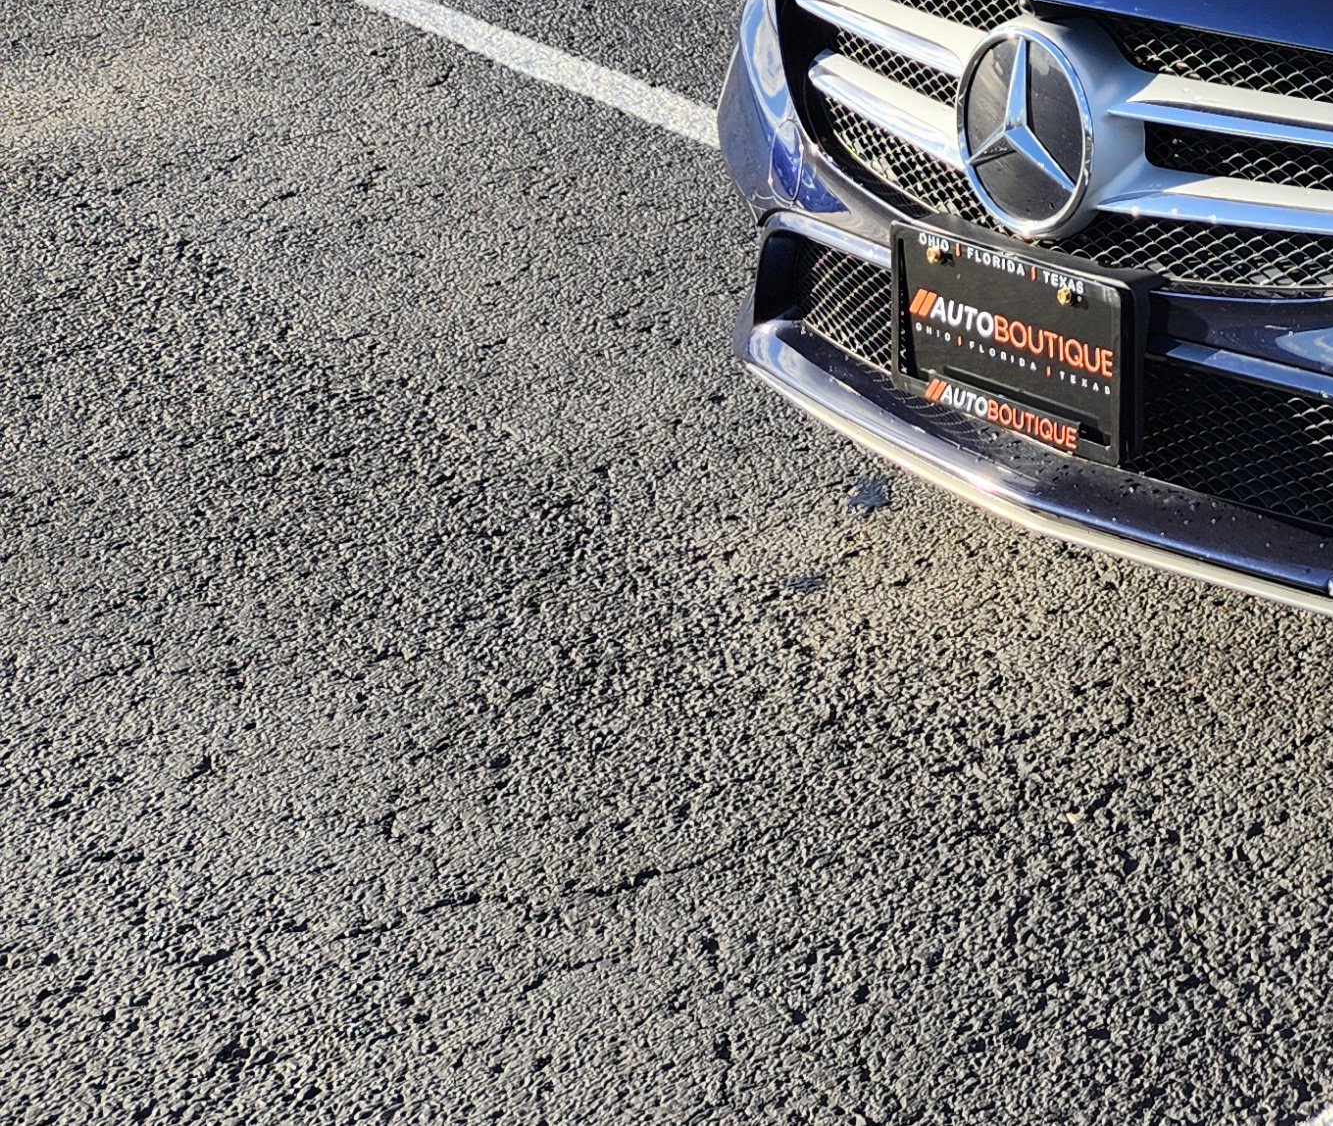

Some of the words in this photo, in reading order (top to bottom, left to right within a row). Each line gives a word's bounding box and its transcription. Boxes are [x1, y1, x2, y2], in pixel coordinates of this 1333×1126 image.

[918, 232, 949, 252] OHIO
[967, 247, 1025, 276] FLORIDA
[1043, 271, 1085, 294] TEXAS
[915, 322, 951, 342] OHIO
[969, 341, 1037, 371] FLORIDA
